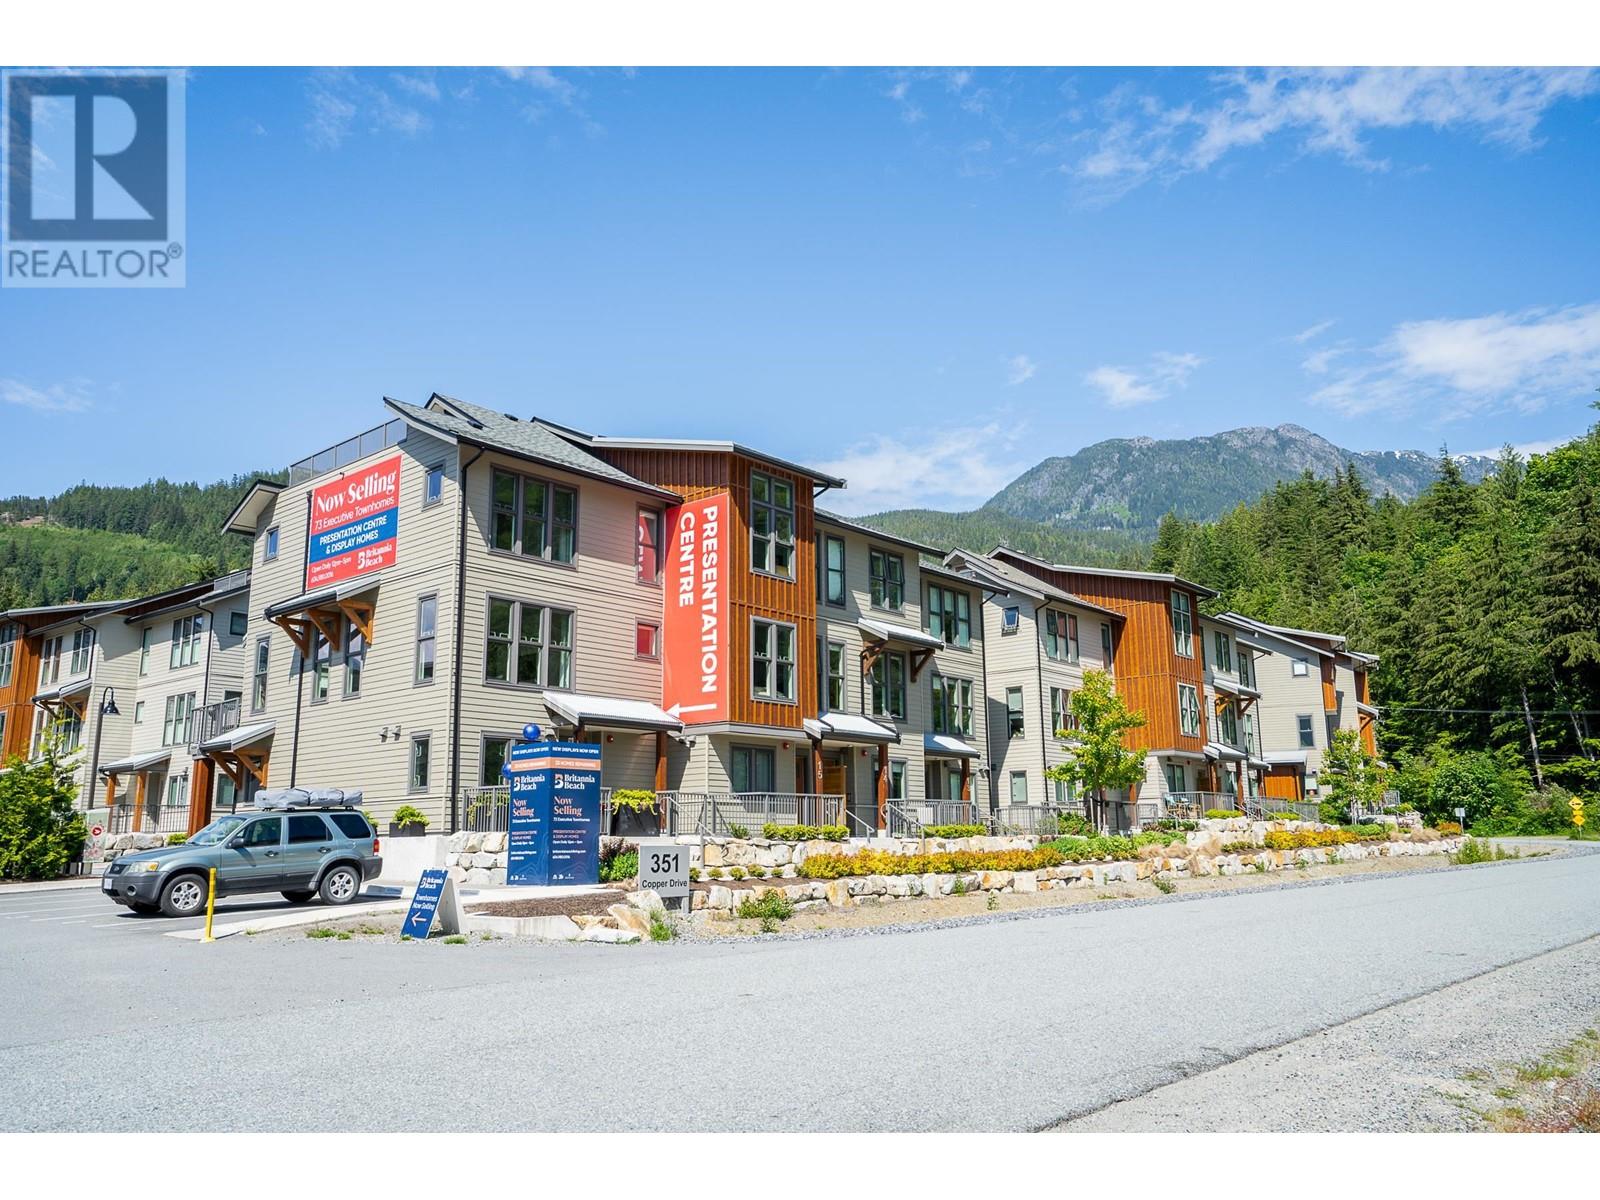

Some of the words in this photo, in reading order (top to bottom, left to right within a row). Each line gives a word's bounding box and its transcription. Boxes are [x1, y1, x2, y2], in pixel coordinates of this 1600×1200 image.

[316, 490, 346, 516] Now
[348, 470, 397, 504] Selling
[315, 520, 322, 530] 73
[323, 510, 354, 528] Executive
[354, 496, 394, 516] Townhomes
[320, 524, 362, 546] PRESENTATION
[363, 515, 388, 532] CENTRE
[326, 545, 331, 554] &
[331, 536, 356, 553] DISPLAY
[356, 530, 378, 544] HOMES
[366, 543, 392, 558] Britannia
[365, 554, 383, 568] Beach
[679, 512, 695, 607] CENTRE
[702, 505, 718, 692] PRESENTATION
[520, 774, 545, 783] Britannia
[564, 774, 595, 783] Britannia
[521, 782, 537, 790] Beach
[513, 798, 527, 807] Now
[554, 796, 573, 805] Now
[513, 807, 534, 817] Selling
[554, 805, 582, 816] Selling
[651, 854, 679, 873] 351
[642, 880, 668, 889] Copper
[670, 879, 688, 887] Drive
[421, 902, 436, 911] Selling
